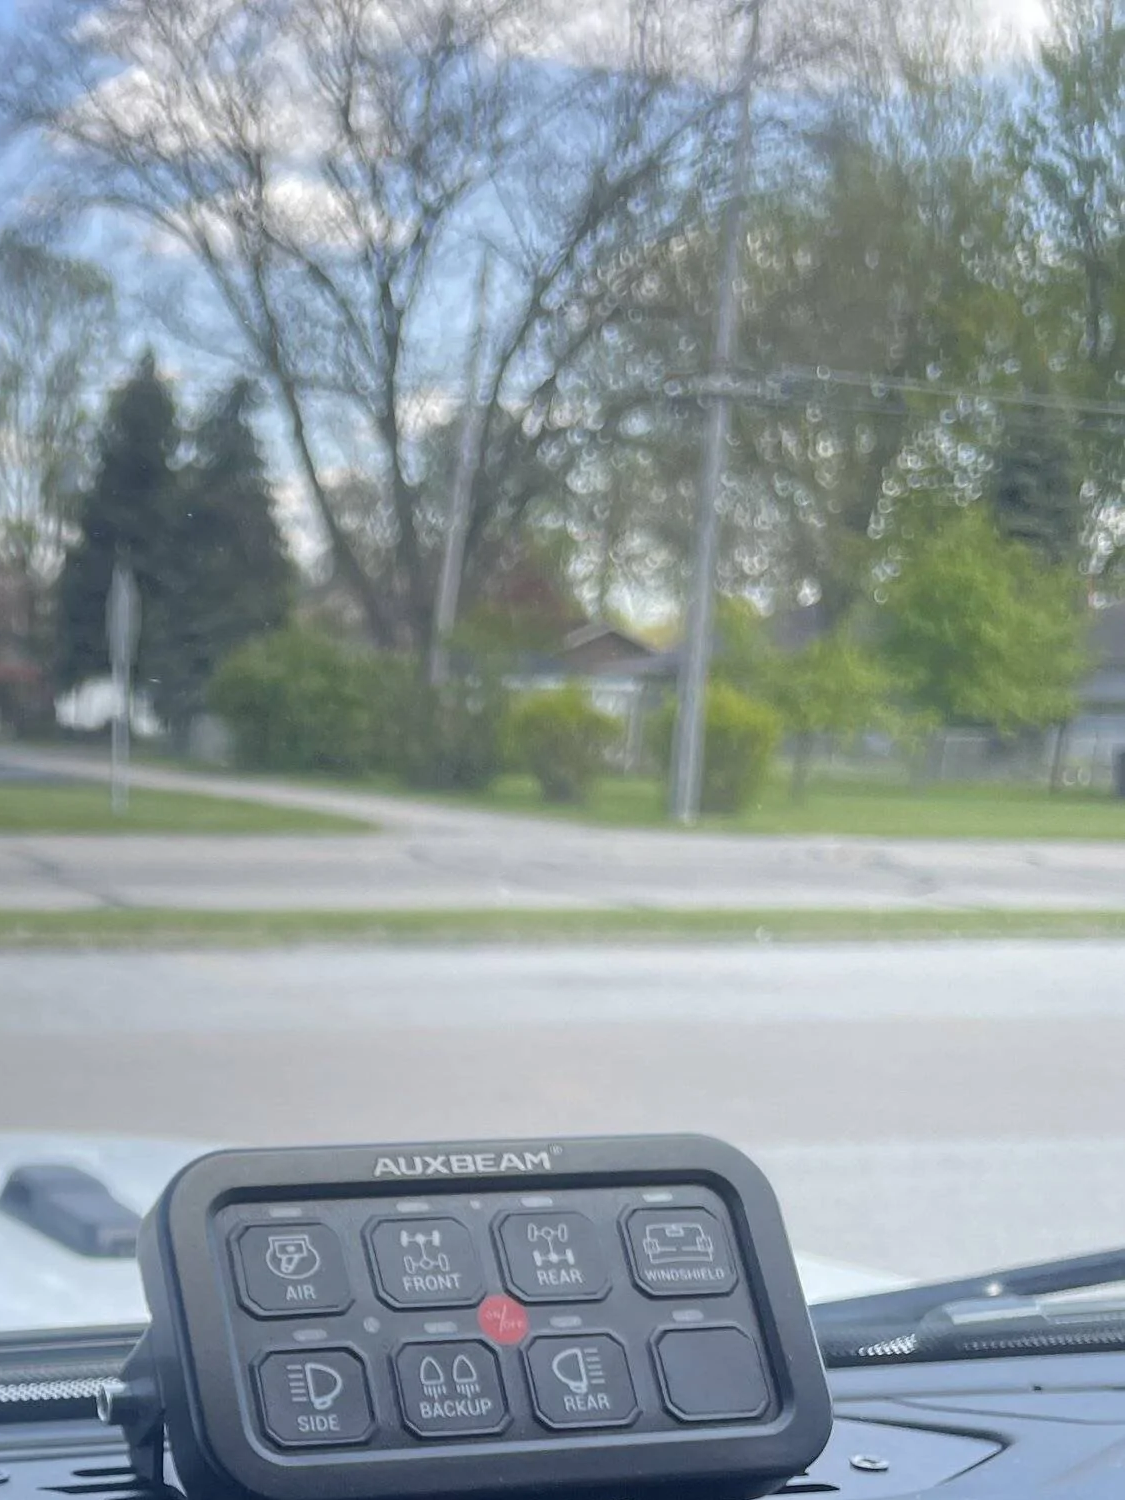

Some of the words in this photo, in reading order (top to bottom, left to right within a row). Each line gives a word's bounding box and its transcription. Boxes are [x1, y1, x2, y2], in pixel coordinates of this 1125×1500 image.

[402, 1272, 461, 1292] FRONT
[536, 1267, 583, 1286] REAR
[645, 1267, 725, 1283] WINDSHIELD
[285, 1284, 316, 1301] AIR
[420, 1398, 493, 1420] BACKUP
[564, 1393, 611, 1412] REAR
[297, 1414, 341, 1432] SIDE
